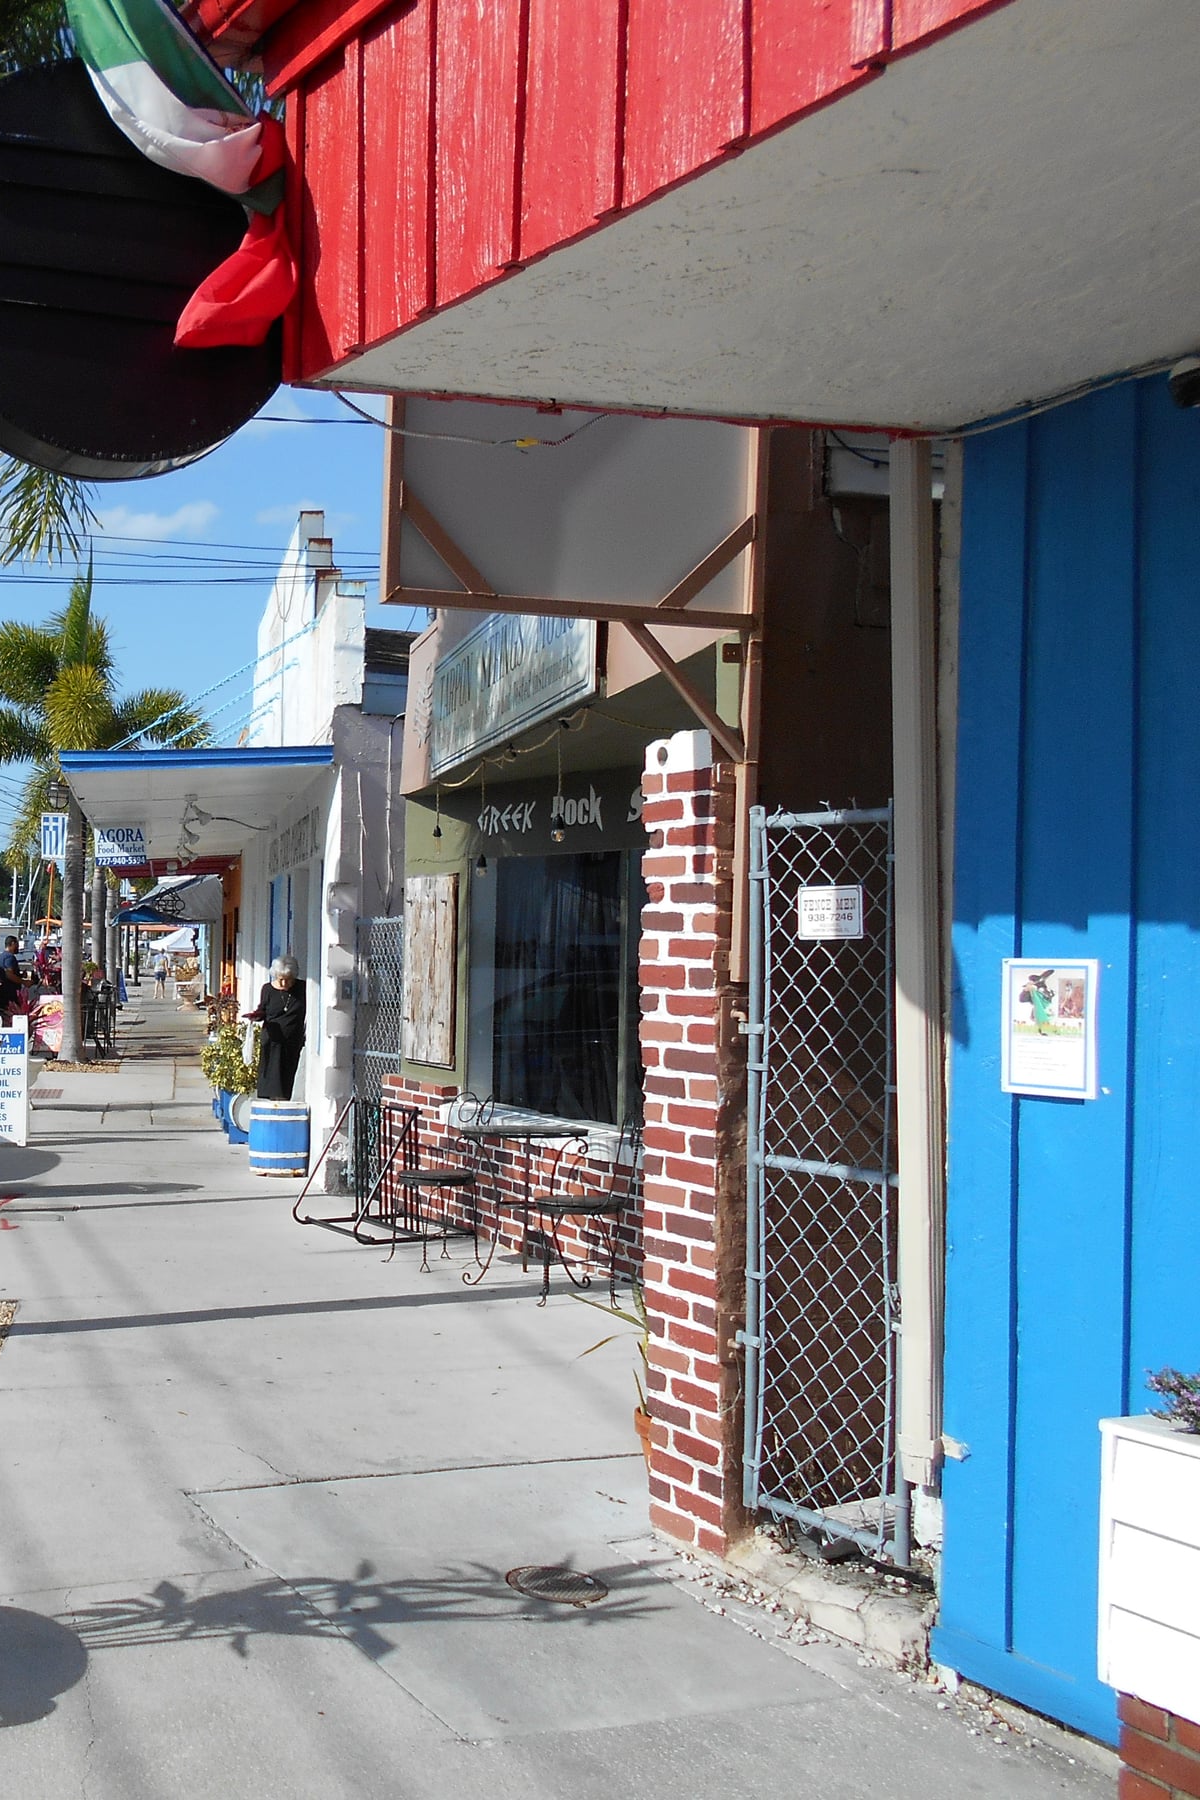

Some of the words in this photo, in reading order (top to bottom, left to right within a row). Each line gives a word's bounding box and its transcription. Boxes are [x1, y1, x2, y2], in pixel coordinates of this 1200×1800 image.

[626, 785, 646, 822] S
[98, 828, 144, 843] AGORA
[97, 844, 115, 854] Food
[118, 843, 145, 853] Market
[98, 856, 145, 866] 727-940-5394
[803, 899, 831, 911] FENCE
[835, 897, 856, 910] MEN
[807, 913, 853, 922] 938-7246
